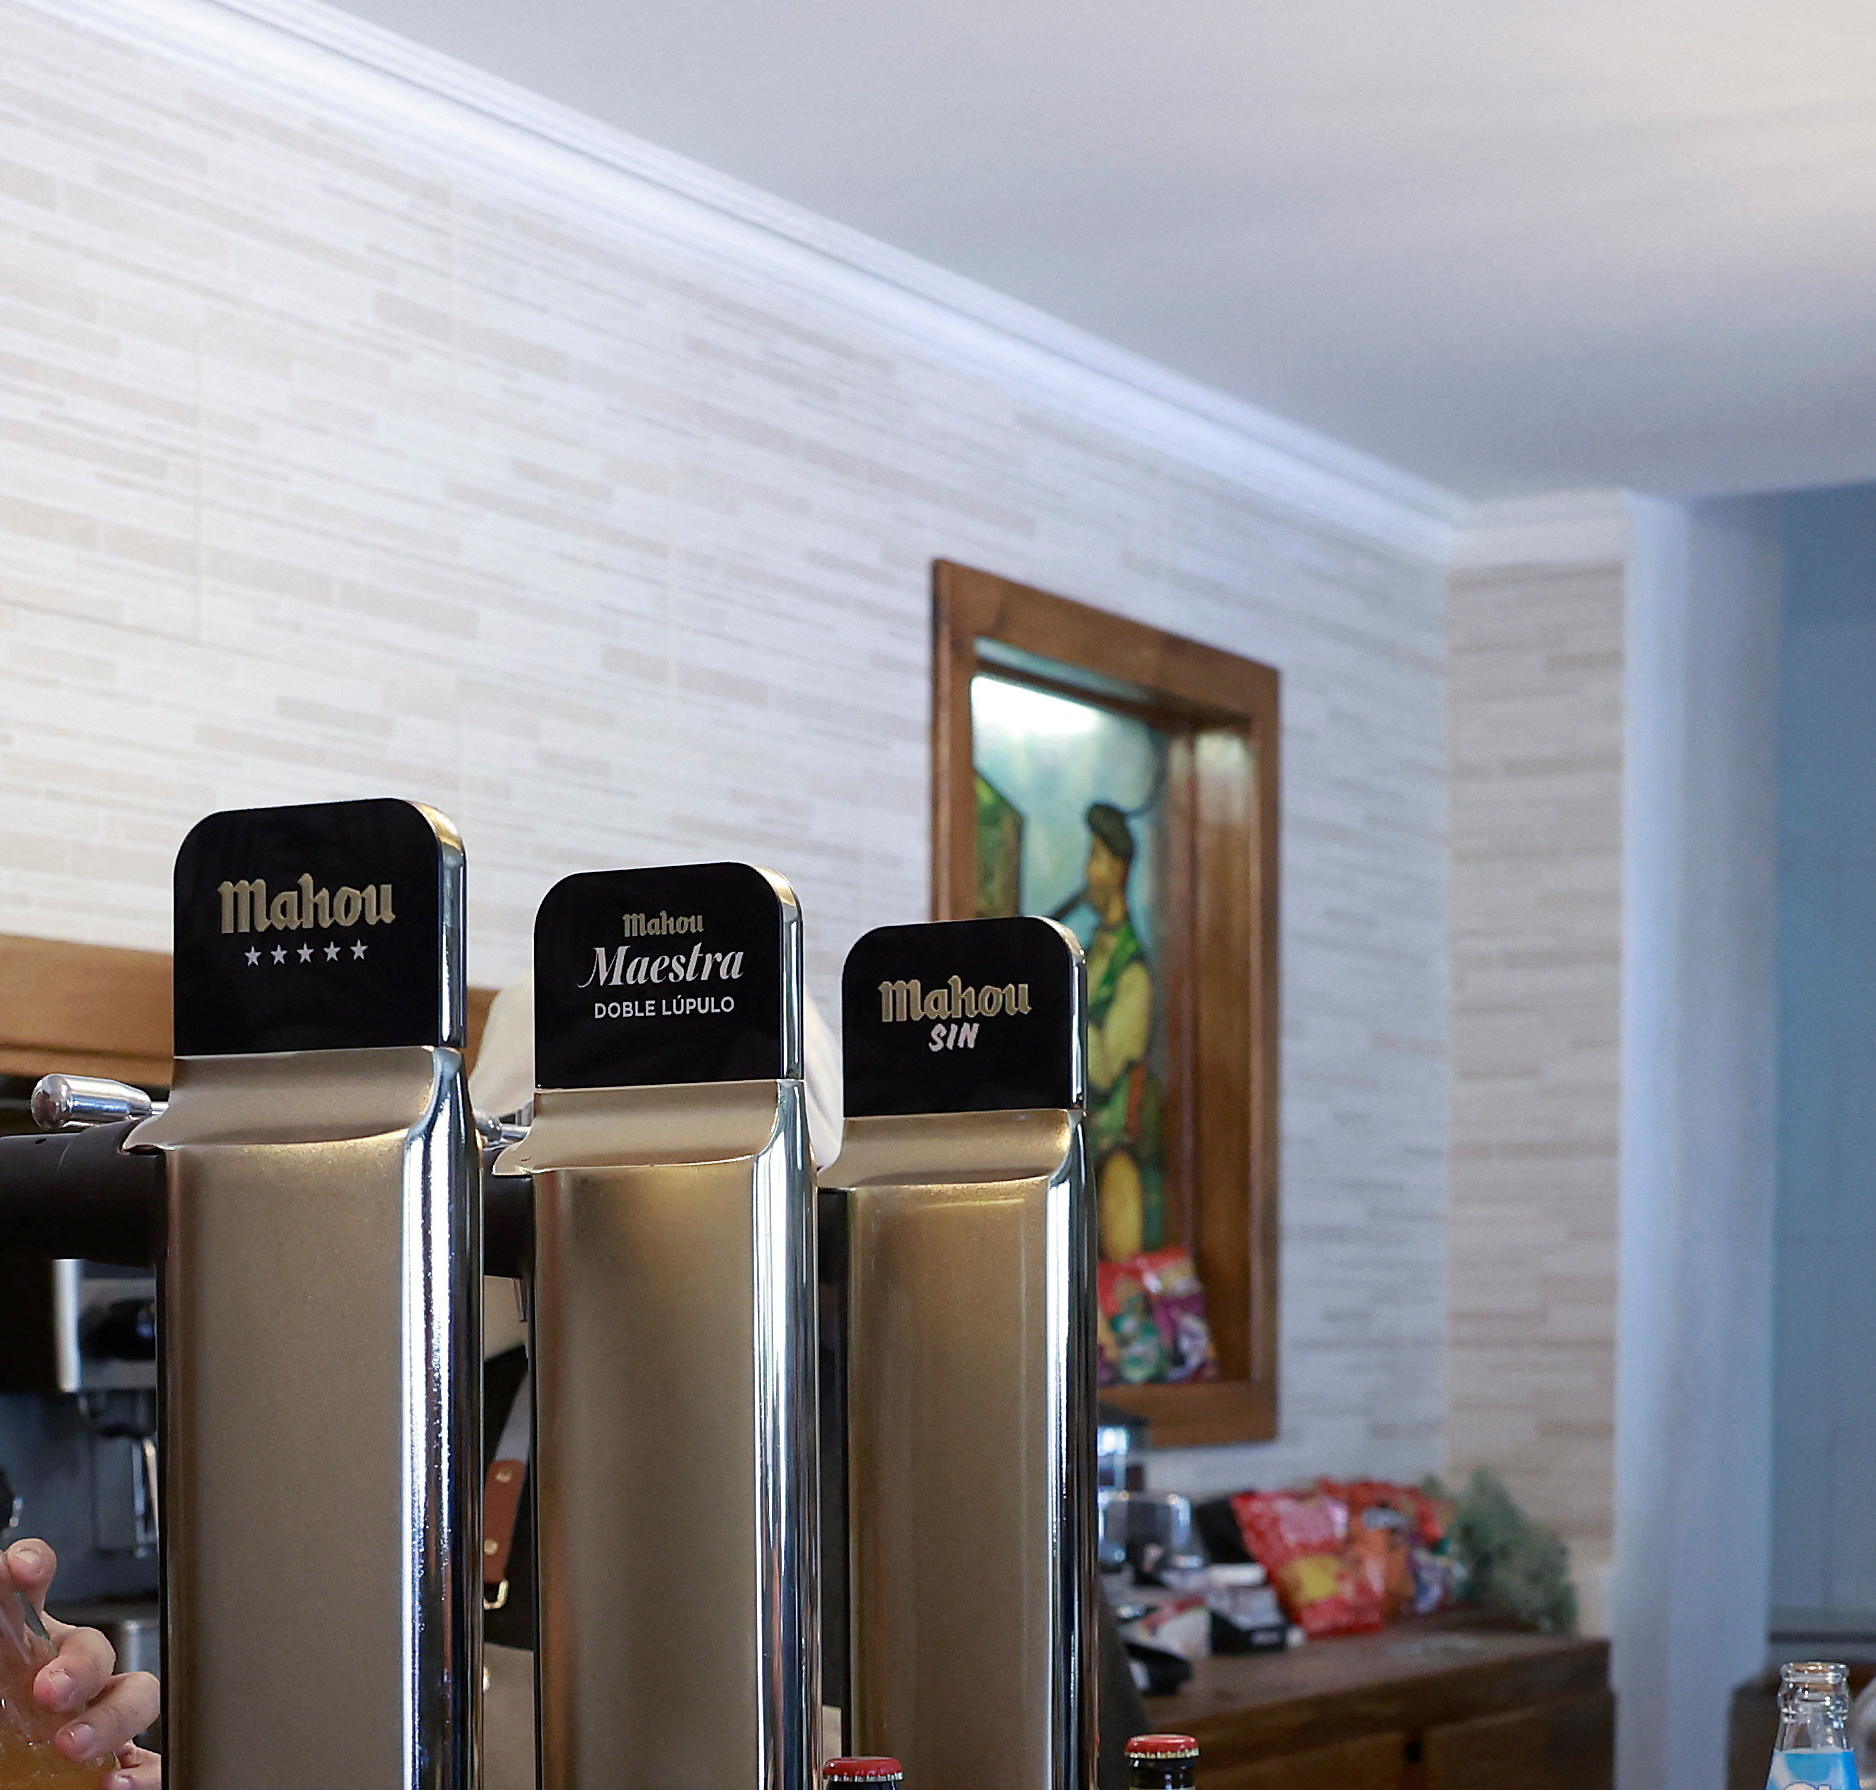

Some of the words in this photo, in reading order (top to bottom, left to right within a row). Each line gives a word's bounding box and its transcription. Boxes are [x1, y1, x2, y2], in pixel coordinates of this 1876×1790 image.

[217, 873, 396, 934] Mahou
[622, 910, 704, 937] Mahou
[577, 942, 744, 988] Maestra
[594, 1001, 656, 1019] DOBLE
[662, 995, 735, 1015] LÚPULO
[878, 975, 1032, 1022] Mahou
[928, 1022, 980, 1052] SIN
